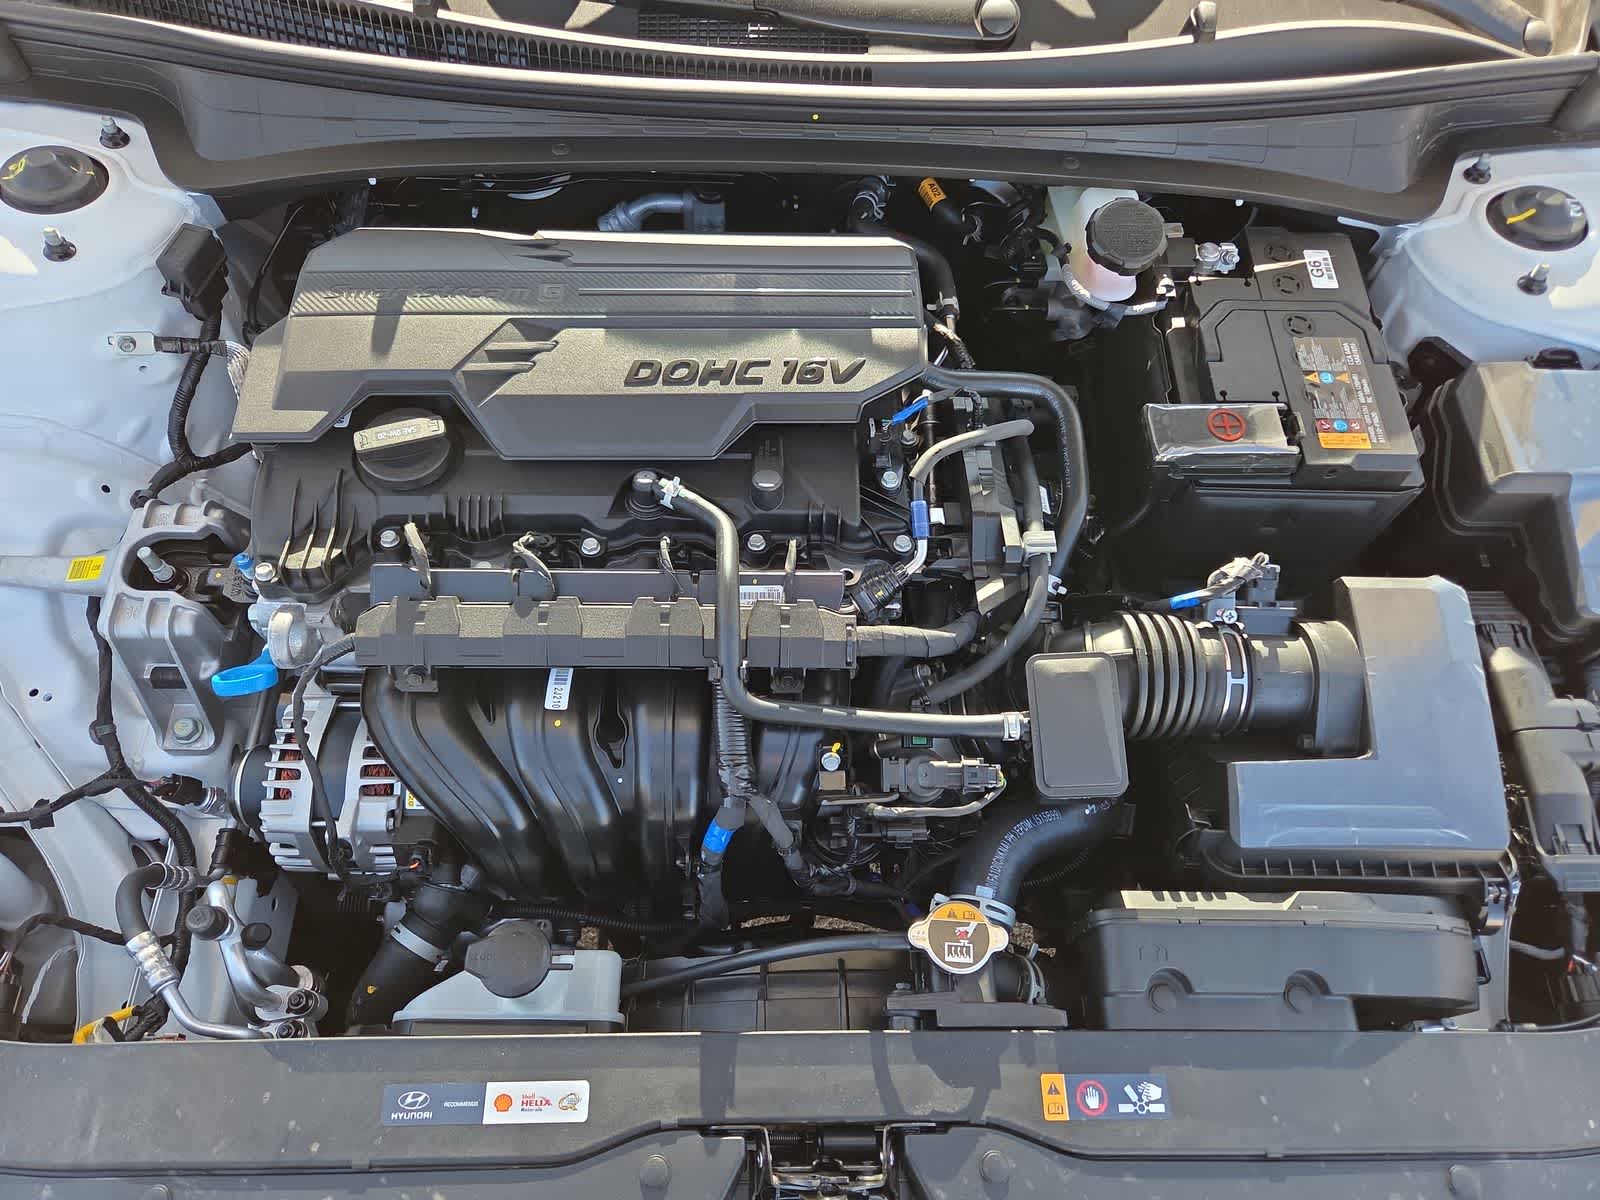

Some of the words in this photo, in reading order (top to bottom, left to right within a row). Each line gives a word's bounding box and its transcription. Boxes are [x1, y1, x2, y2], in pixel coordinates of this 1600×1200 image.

[1309, 260, 1325, 278] G6
[623, 359, 771, 387] DOHC
[781, 358, 867, 385] 16V
[521, 1099, 549, 1107] HELIX
[391, 1111, 433, 1120] HYUNDAI
